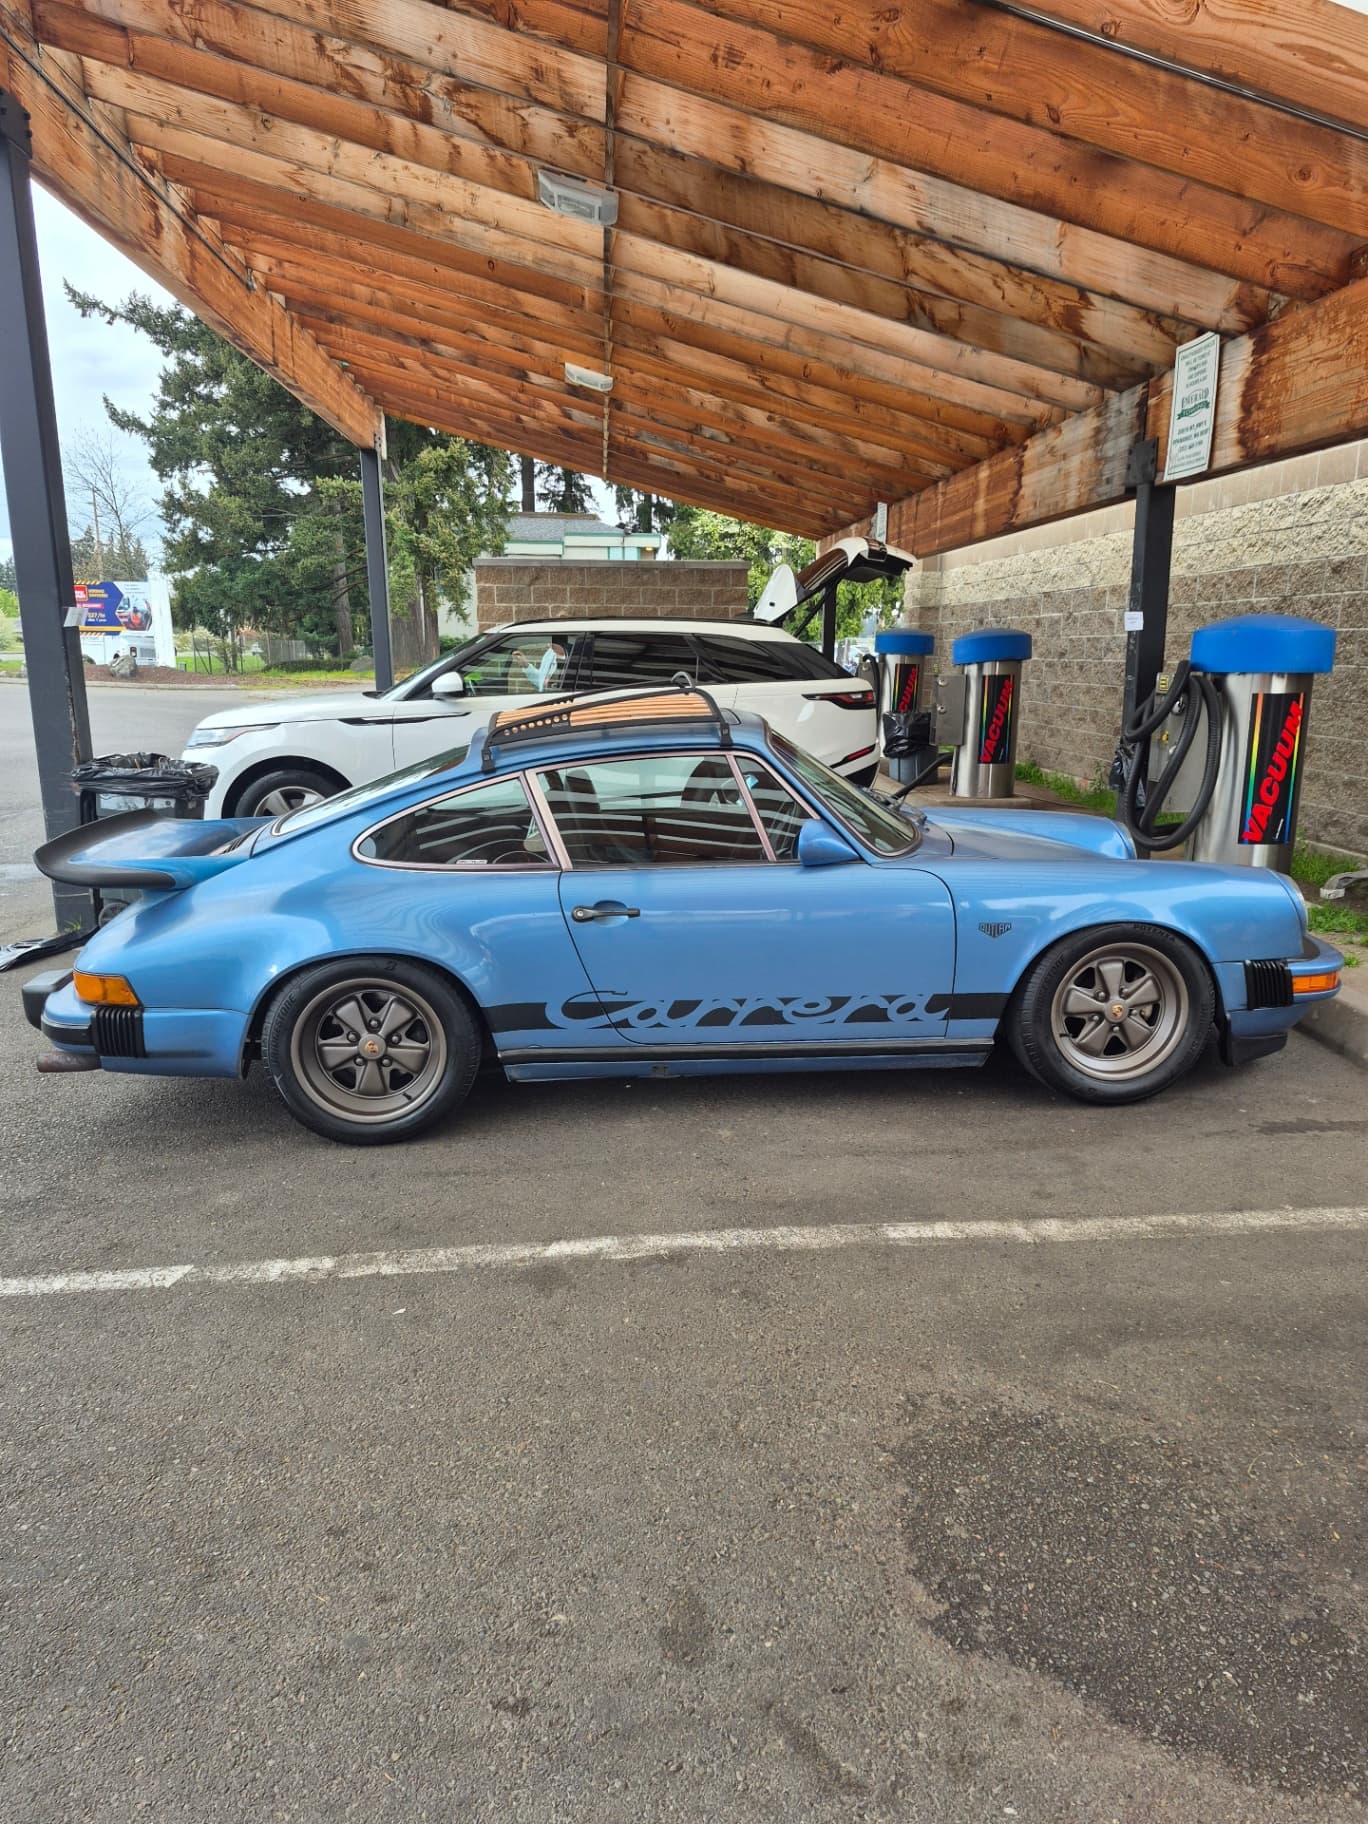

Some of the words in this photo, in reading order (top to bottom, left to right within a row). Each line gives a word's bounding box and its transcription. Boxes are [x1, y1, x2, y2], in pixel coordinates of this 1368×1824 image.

[898, 665, 918, 712] CUUM
[980, 679, 1013, 763] VACUUM
[1242, 700, 1304, 842] VACUUM
[545, 990, 950, 1030] Carrera
